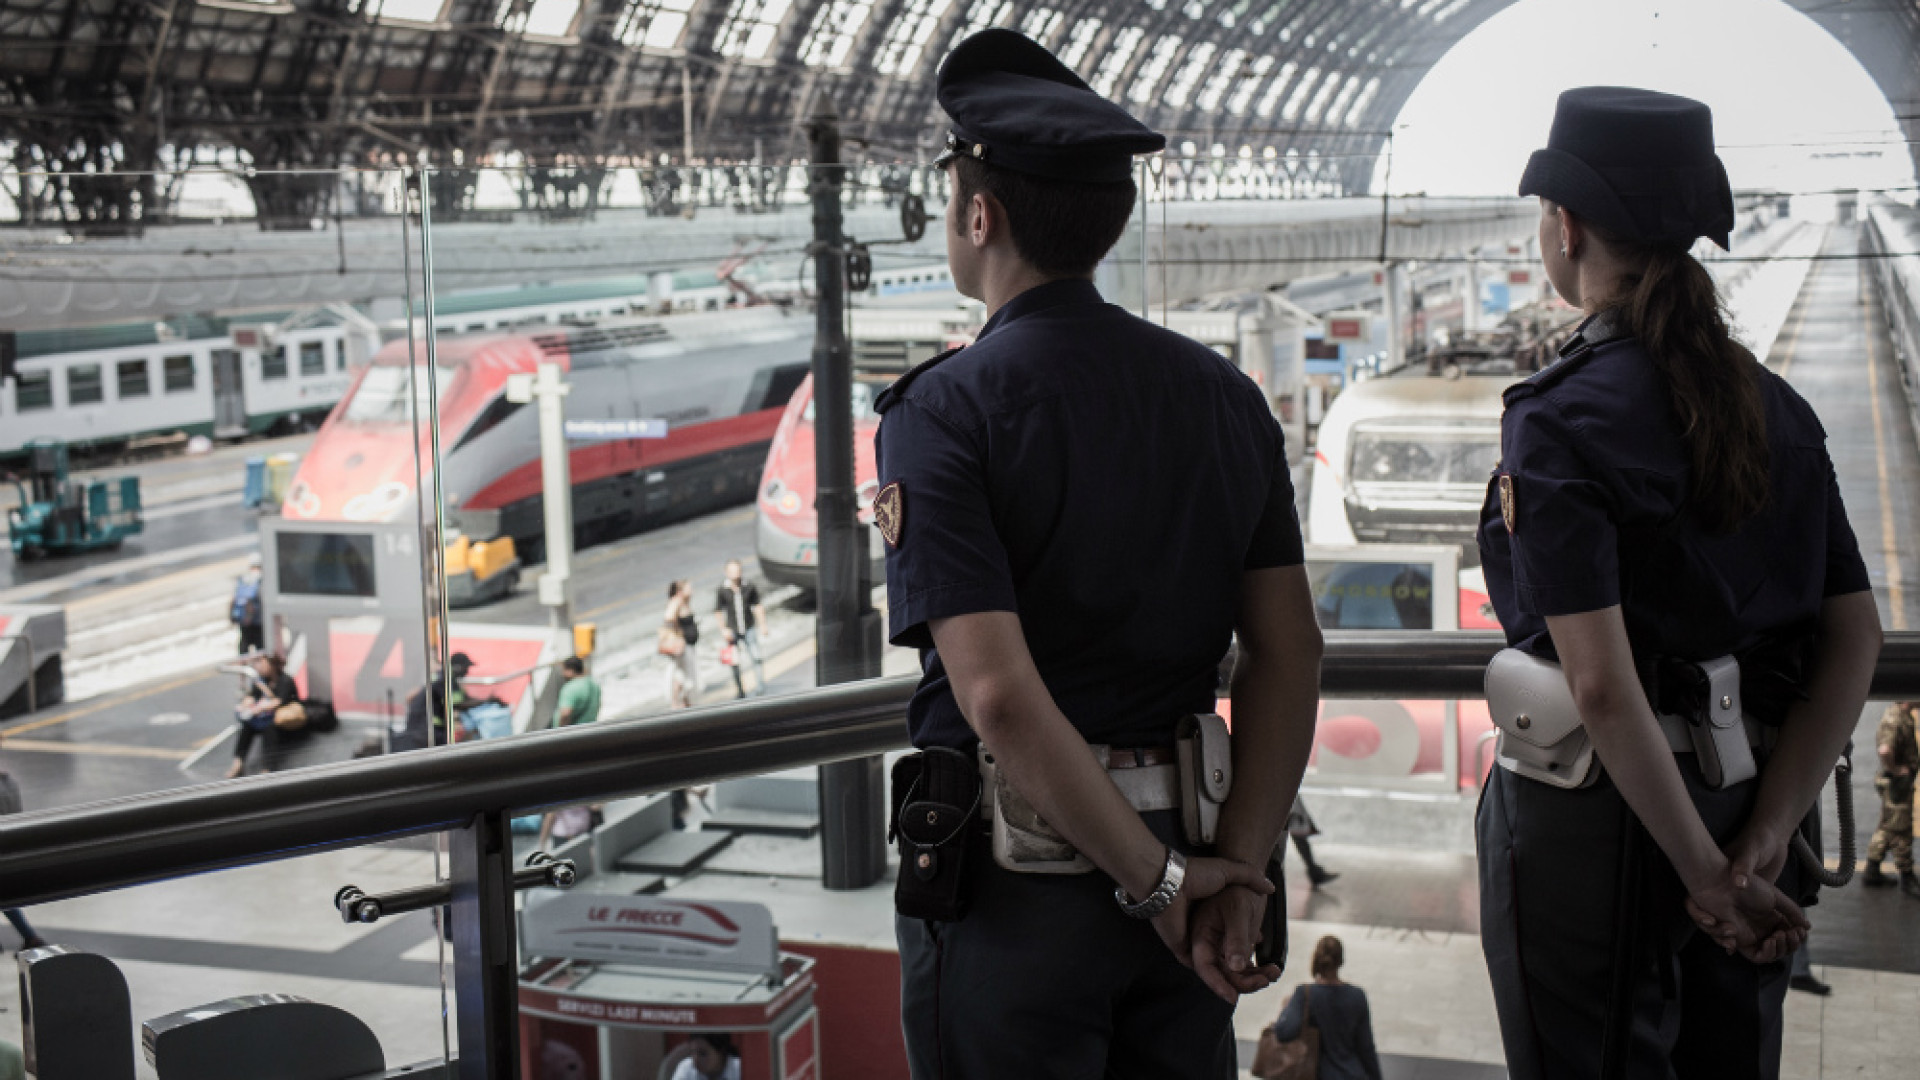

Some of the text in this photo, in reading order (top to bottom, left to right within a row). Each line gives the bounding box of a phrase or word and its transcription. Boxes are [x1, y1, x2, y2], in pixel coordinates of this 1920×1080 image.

[386, 534, 412, 555] 14
[1313, 584, 1430, 599] OMORROW
[588, 905, 685, 927] LE FRECCE
[606, 1005, 639, 1020] LAST
[640, 1008, 696, 1024] MINUTE
